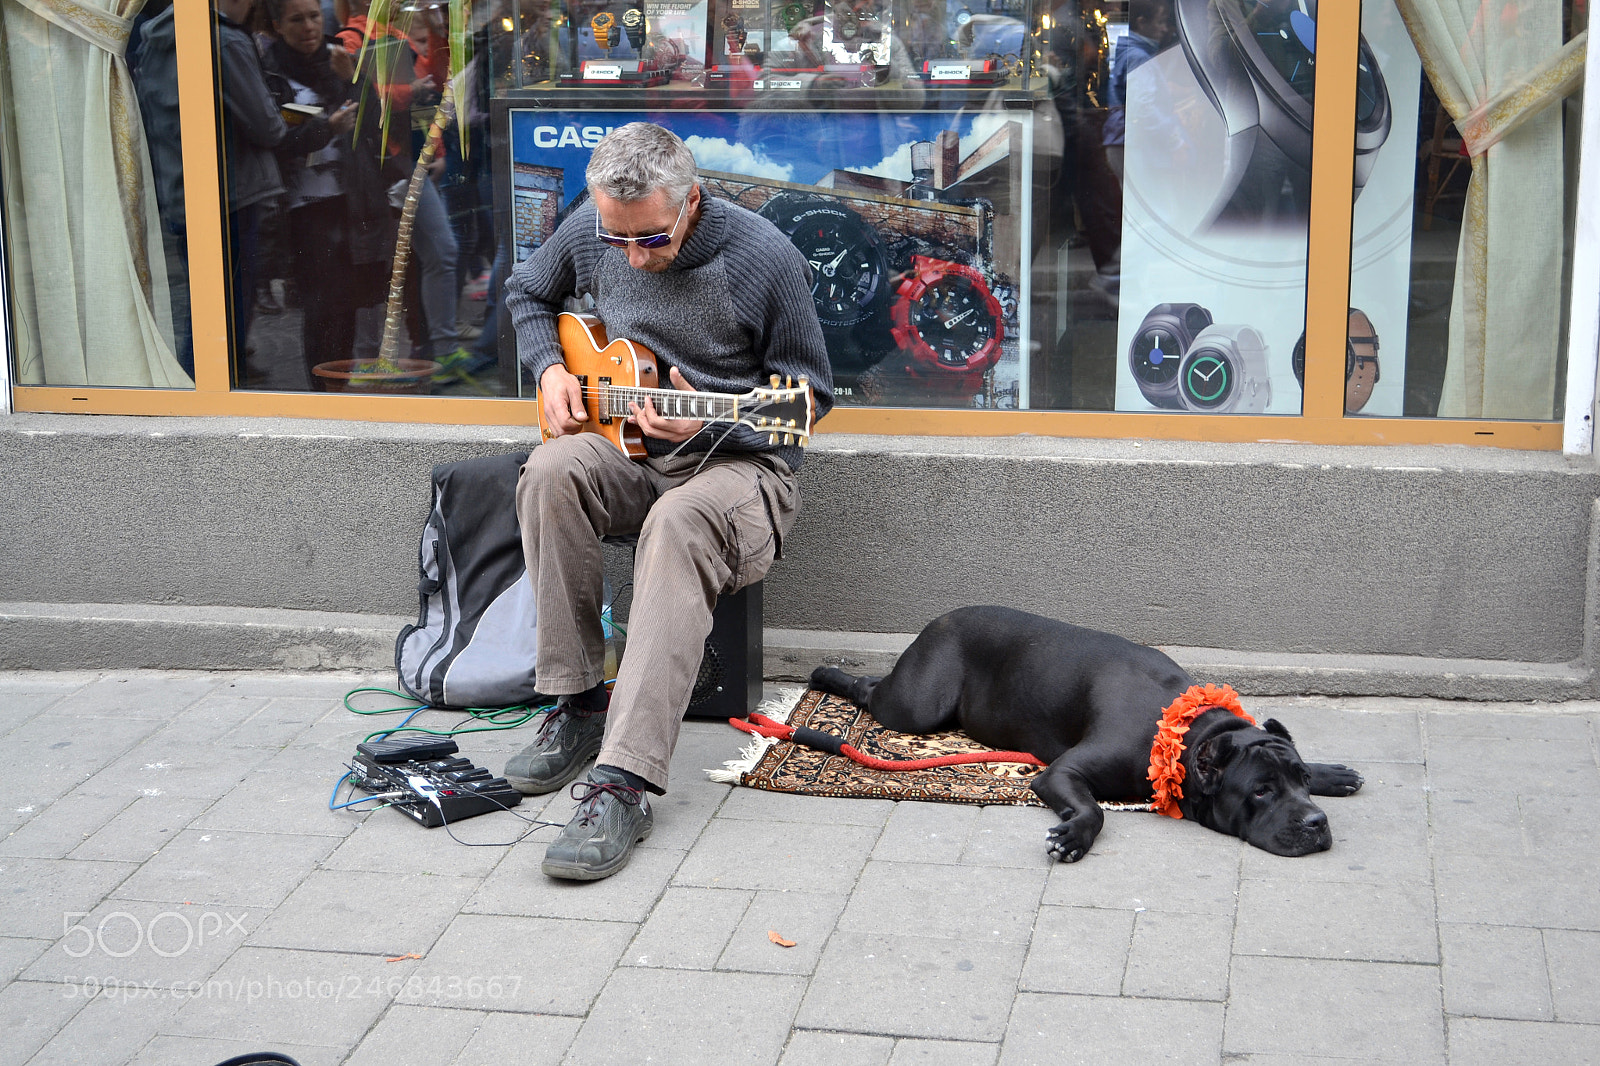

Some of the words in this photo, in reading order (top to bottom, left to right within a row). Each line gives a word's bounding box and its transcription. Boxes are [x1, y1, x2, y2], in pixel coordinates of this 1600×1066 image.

[533, 125, 614, 148] CAS
[792, 208, 848, 222] G-SHOCK
[833, 387, 853, 396] 20-1A
